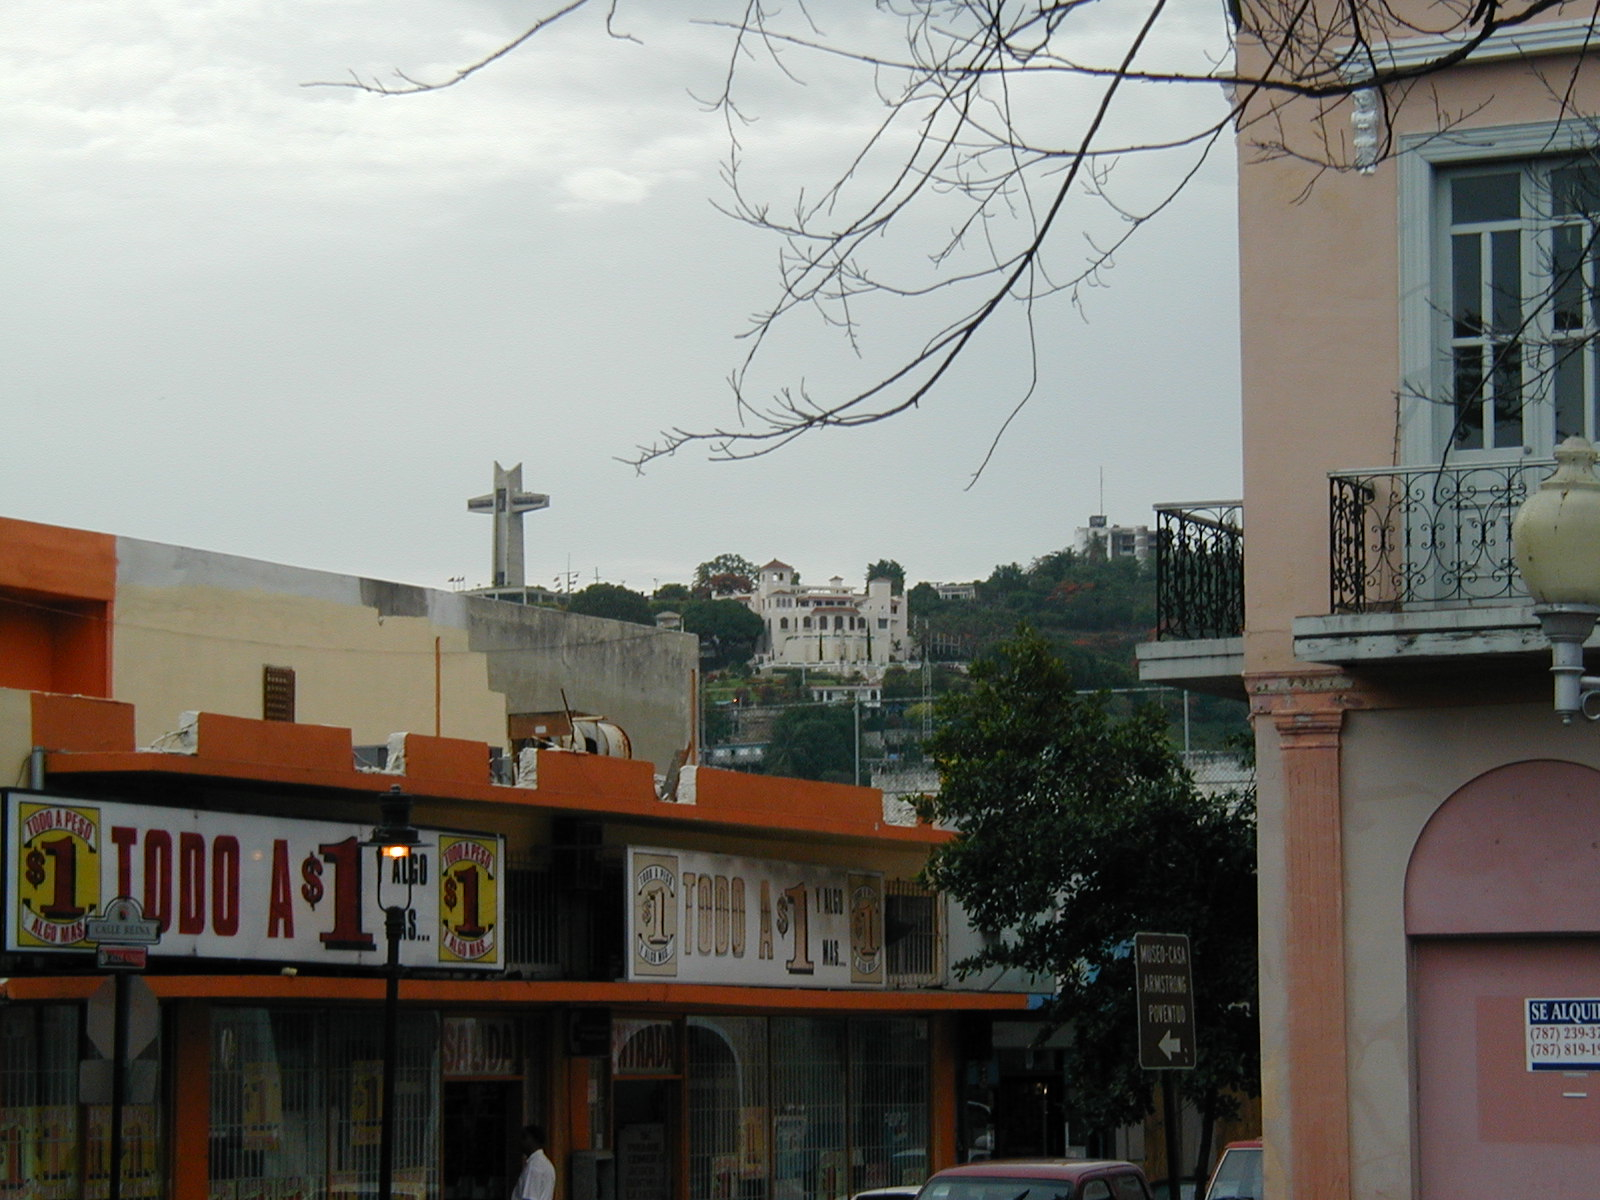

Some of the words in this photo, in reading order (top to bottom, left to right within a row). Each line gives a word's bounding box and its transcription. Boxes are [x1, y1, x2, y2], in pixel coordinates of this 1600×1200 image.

[26, 810, 54, 836] TODO
[56, 810, 62, 827] A
[66, 811, 93, 840] PESO
[443, 844, 463, 867] TODO
[465, 842, 469, 856] A
[471, 844, 492, 867] PESO
[26, 836, 85, 919] $1
[111, 826, 240, 936] TODO
[268, 838, 294, 938] A
[301, 836, 376, 951] $1
[444, 865, 486, 937] $1
[815, 888, 820, 914] Y
[824, 888, 843, 915] ALGO
[642, 887, 669, 944] $1
[683, 872, 745, 959] TODO
[759, 879, 774, 960] A
[776, 881, 814, 976] $1
[32, 918, 57, 941] ALGO
[449, 938, 467, 957] ALGO
[1140, 944, 1187, 964] MUSEO-CASA
[1144, 974, 1187, 994] ARMSTRONG
[1531, 1002, 1548, 1020] SE
[1551, 1002, 1600, 1023] ALQUI
[1531, 1027, 1560, 1042] (787)
[1531, 1043, 1561, 1058] (787)
